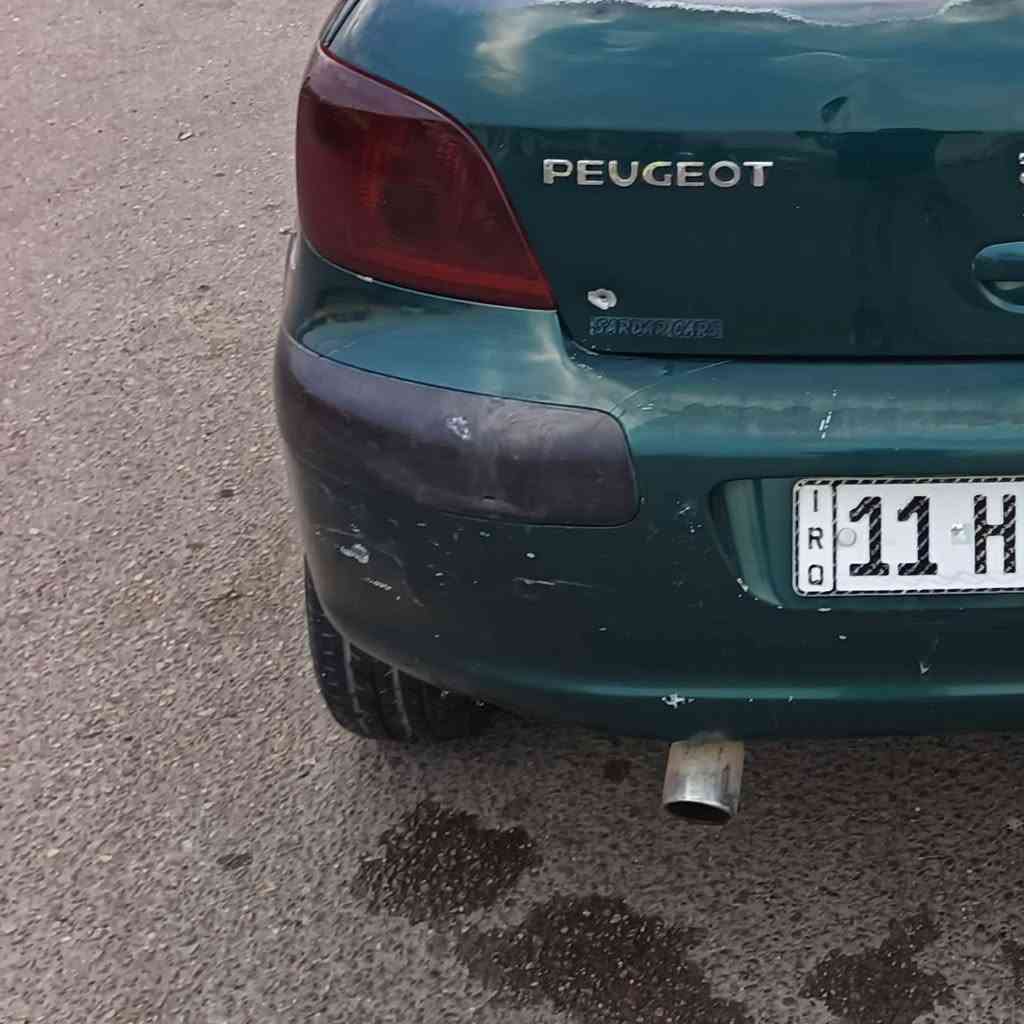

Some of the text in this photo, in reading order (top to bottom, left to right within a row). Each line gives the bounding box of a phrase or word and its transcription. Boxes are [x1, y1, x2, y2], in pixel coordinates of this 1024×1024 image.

[543, 158, 774, 188] PEUGEOT
[849, 495, 938, 577] 11
[972, 493, 1017, 575] H
